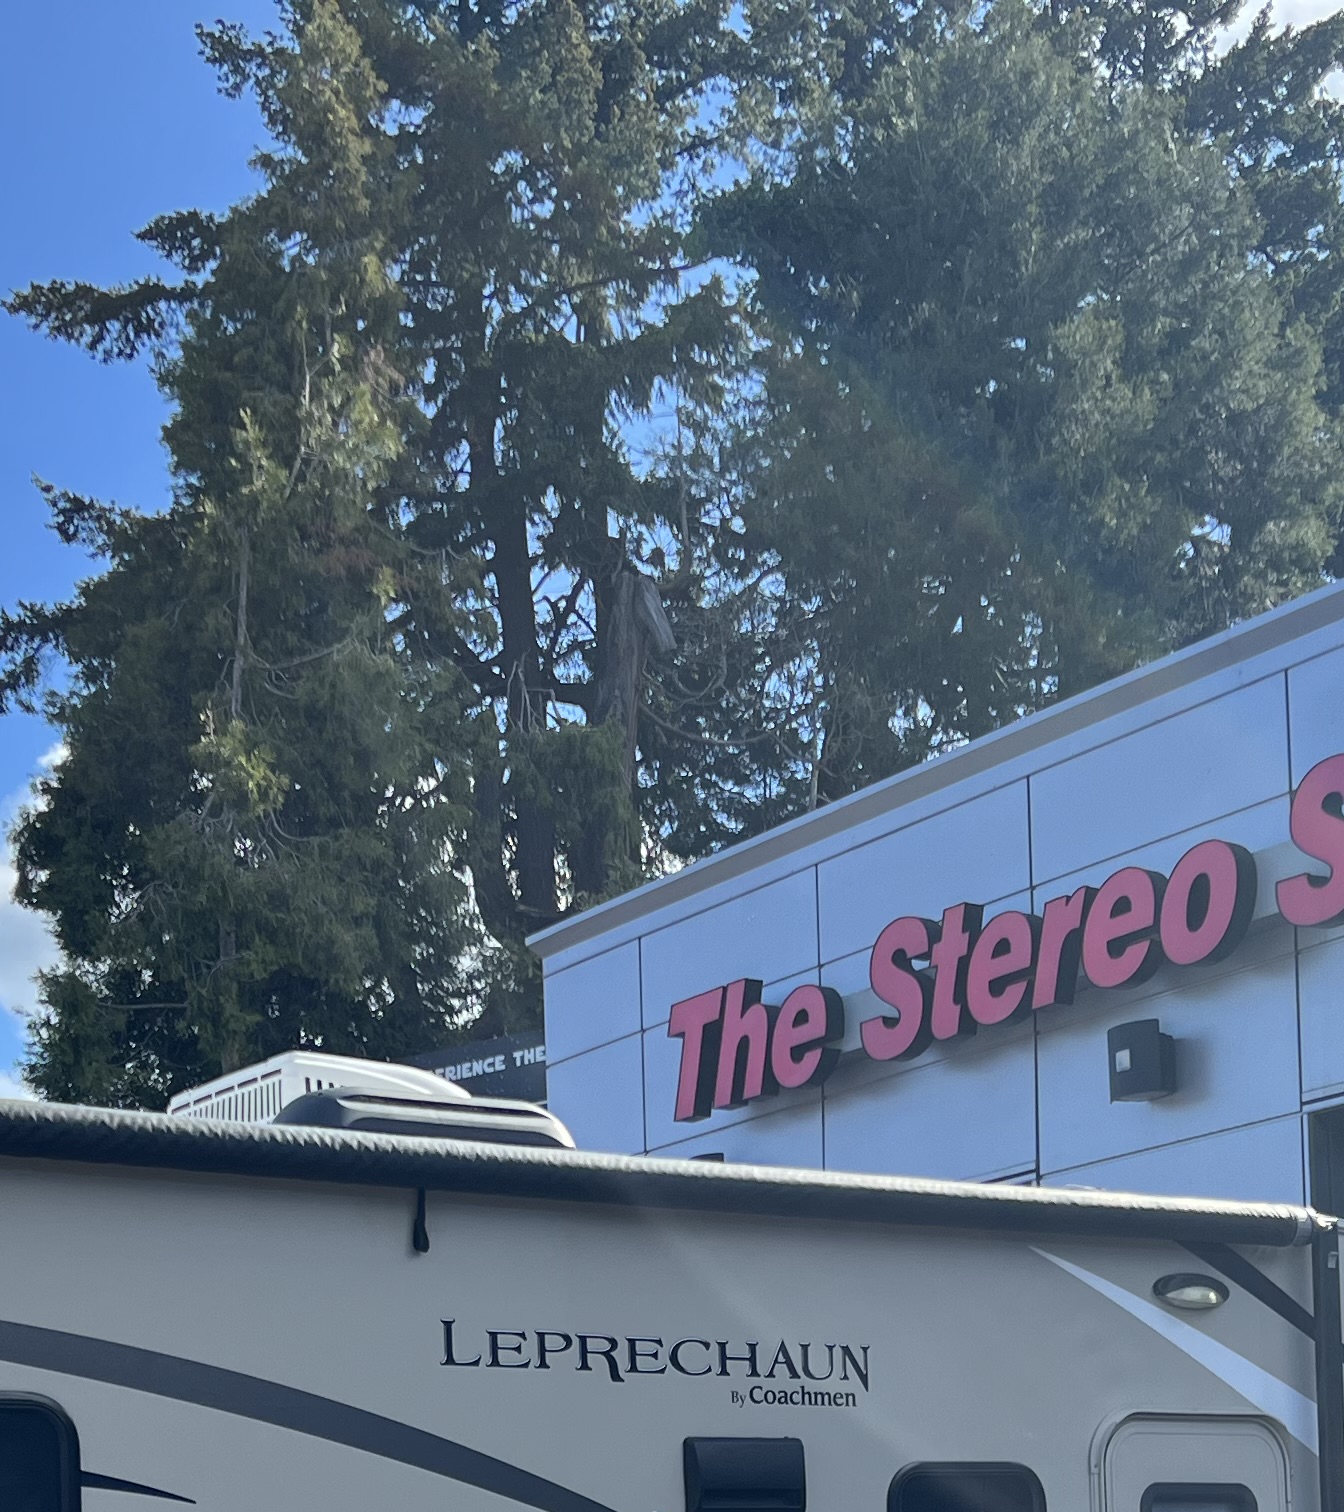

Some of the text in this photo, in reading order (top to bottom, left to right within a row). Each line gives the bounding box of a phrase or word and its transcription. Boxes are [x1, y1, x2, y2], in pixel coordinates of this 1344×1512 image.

[667, 977, 844, 1123] The
[859, 838, 1256, 1062] Stereo
[512, 1045, 546, 1068] THE
[439, 1317, 871, 1393] LEPRECHAUN
[730, 1385, 858, 1409] By Coachmen
